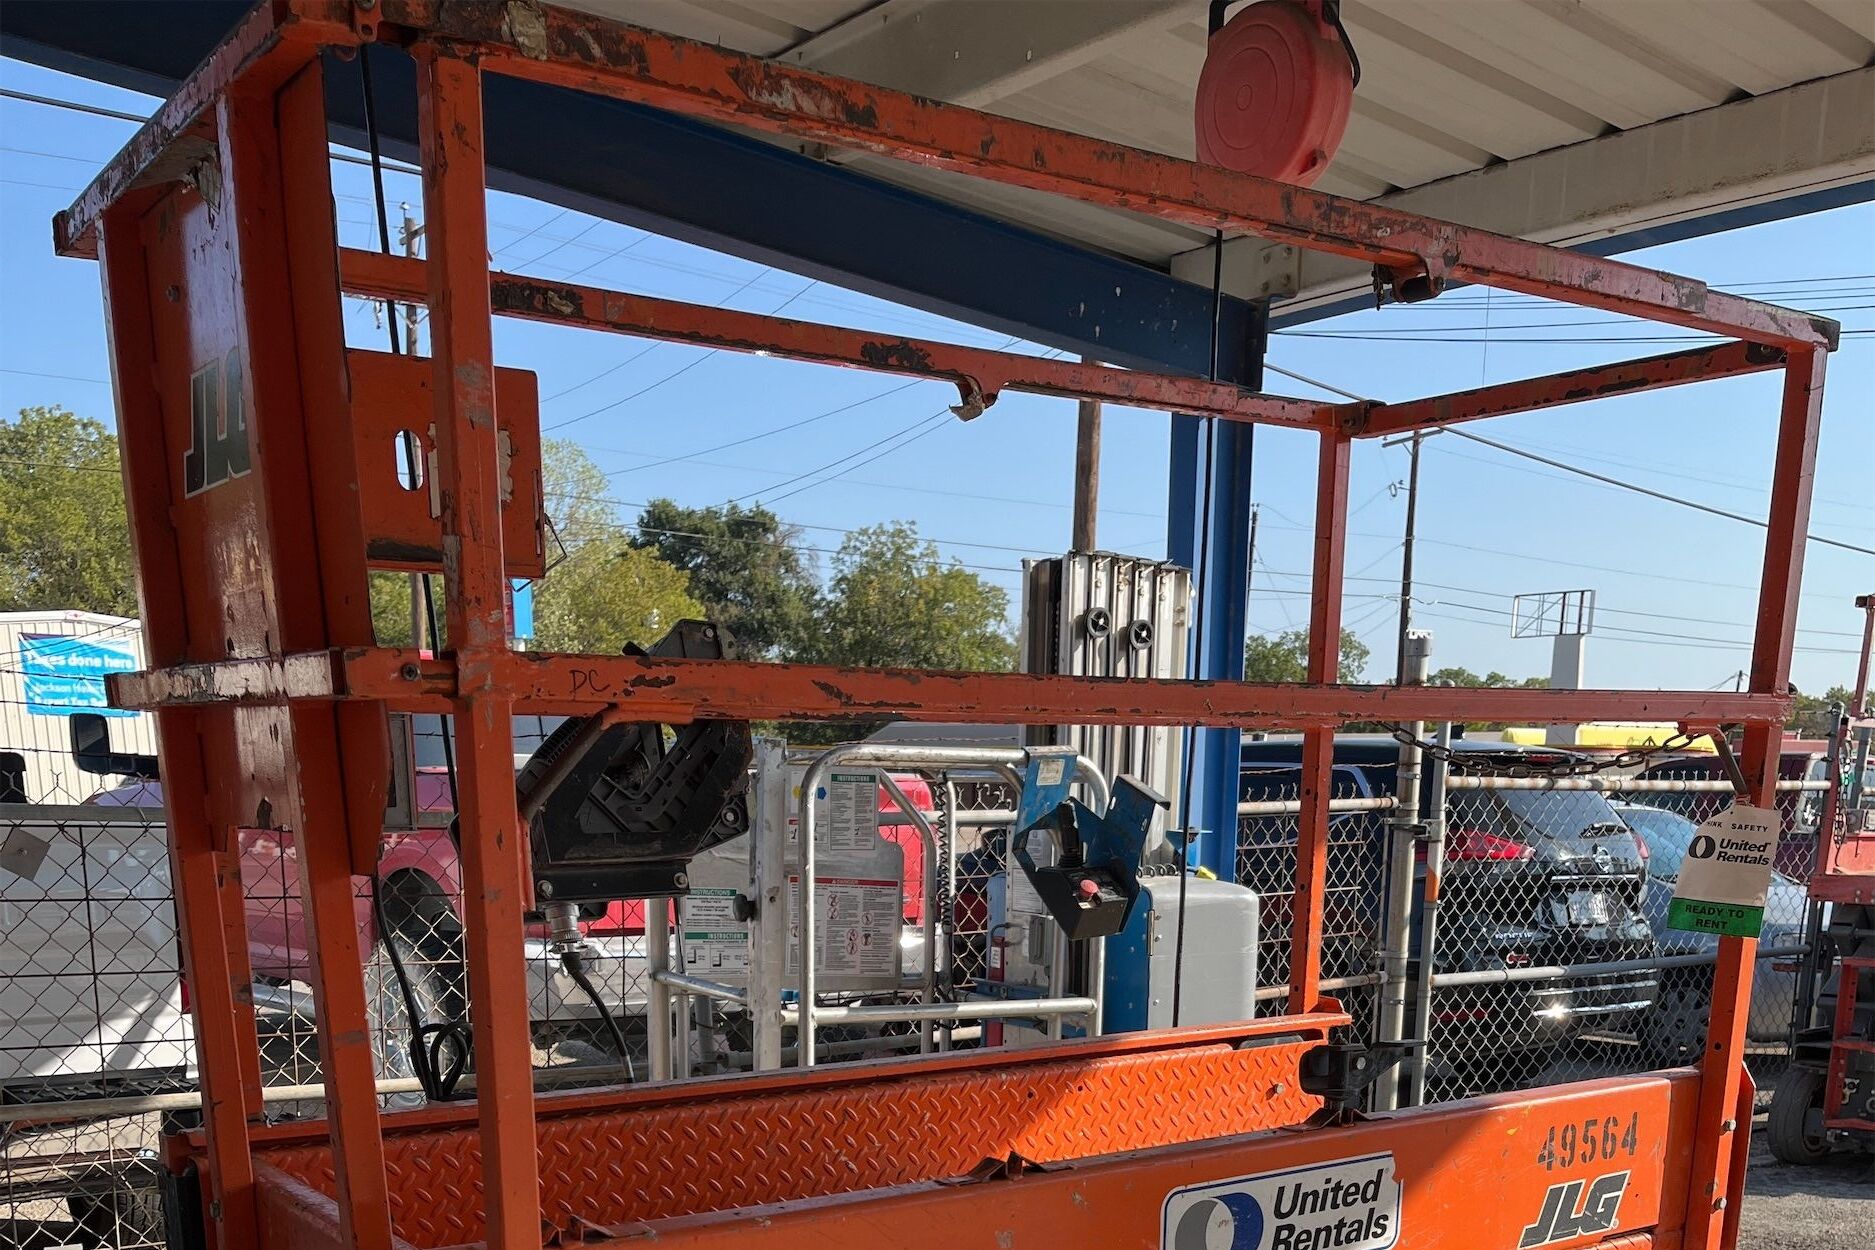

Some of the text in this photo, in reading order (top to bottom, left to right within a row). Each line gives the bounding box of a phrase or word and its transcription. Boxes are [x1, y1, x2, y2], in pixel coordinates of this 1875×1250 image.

[68, 652, 102, 667] done
[104, 654, 133, 669] here
[569, 669, 610, 692] DC
[1731, 822, 1768, 833] SAFETY
[1720, 838, 1769, 853] United
[1716, 851, 1769, 866] Rentals
[1685, 903, 1744, 918] READY TO
[1695, 918, 1728, 930] RENT
[1537, 1112, 1638, 1171] 49564
[1273, 1168, 1384, 1220] United
[1518, 1170, 1632, 1250] JLG
